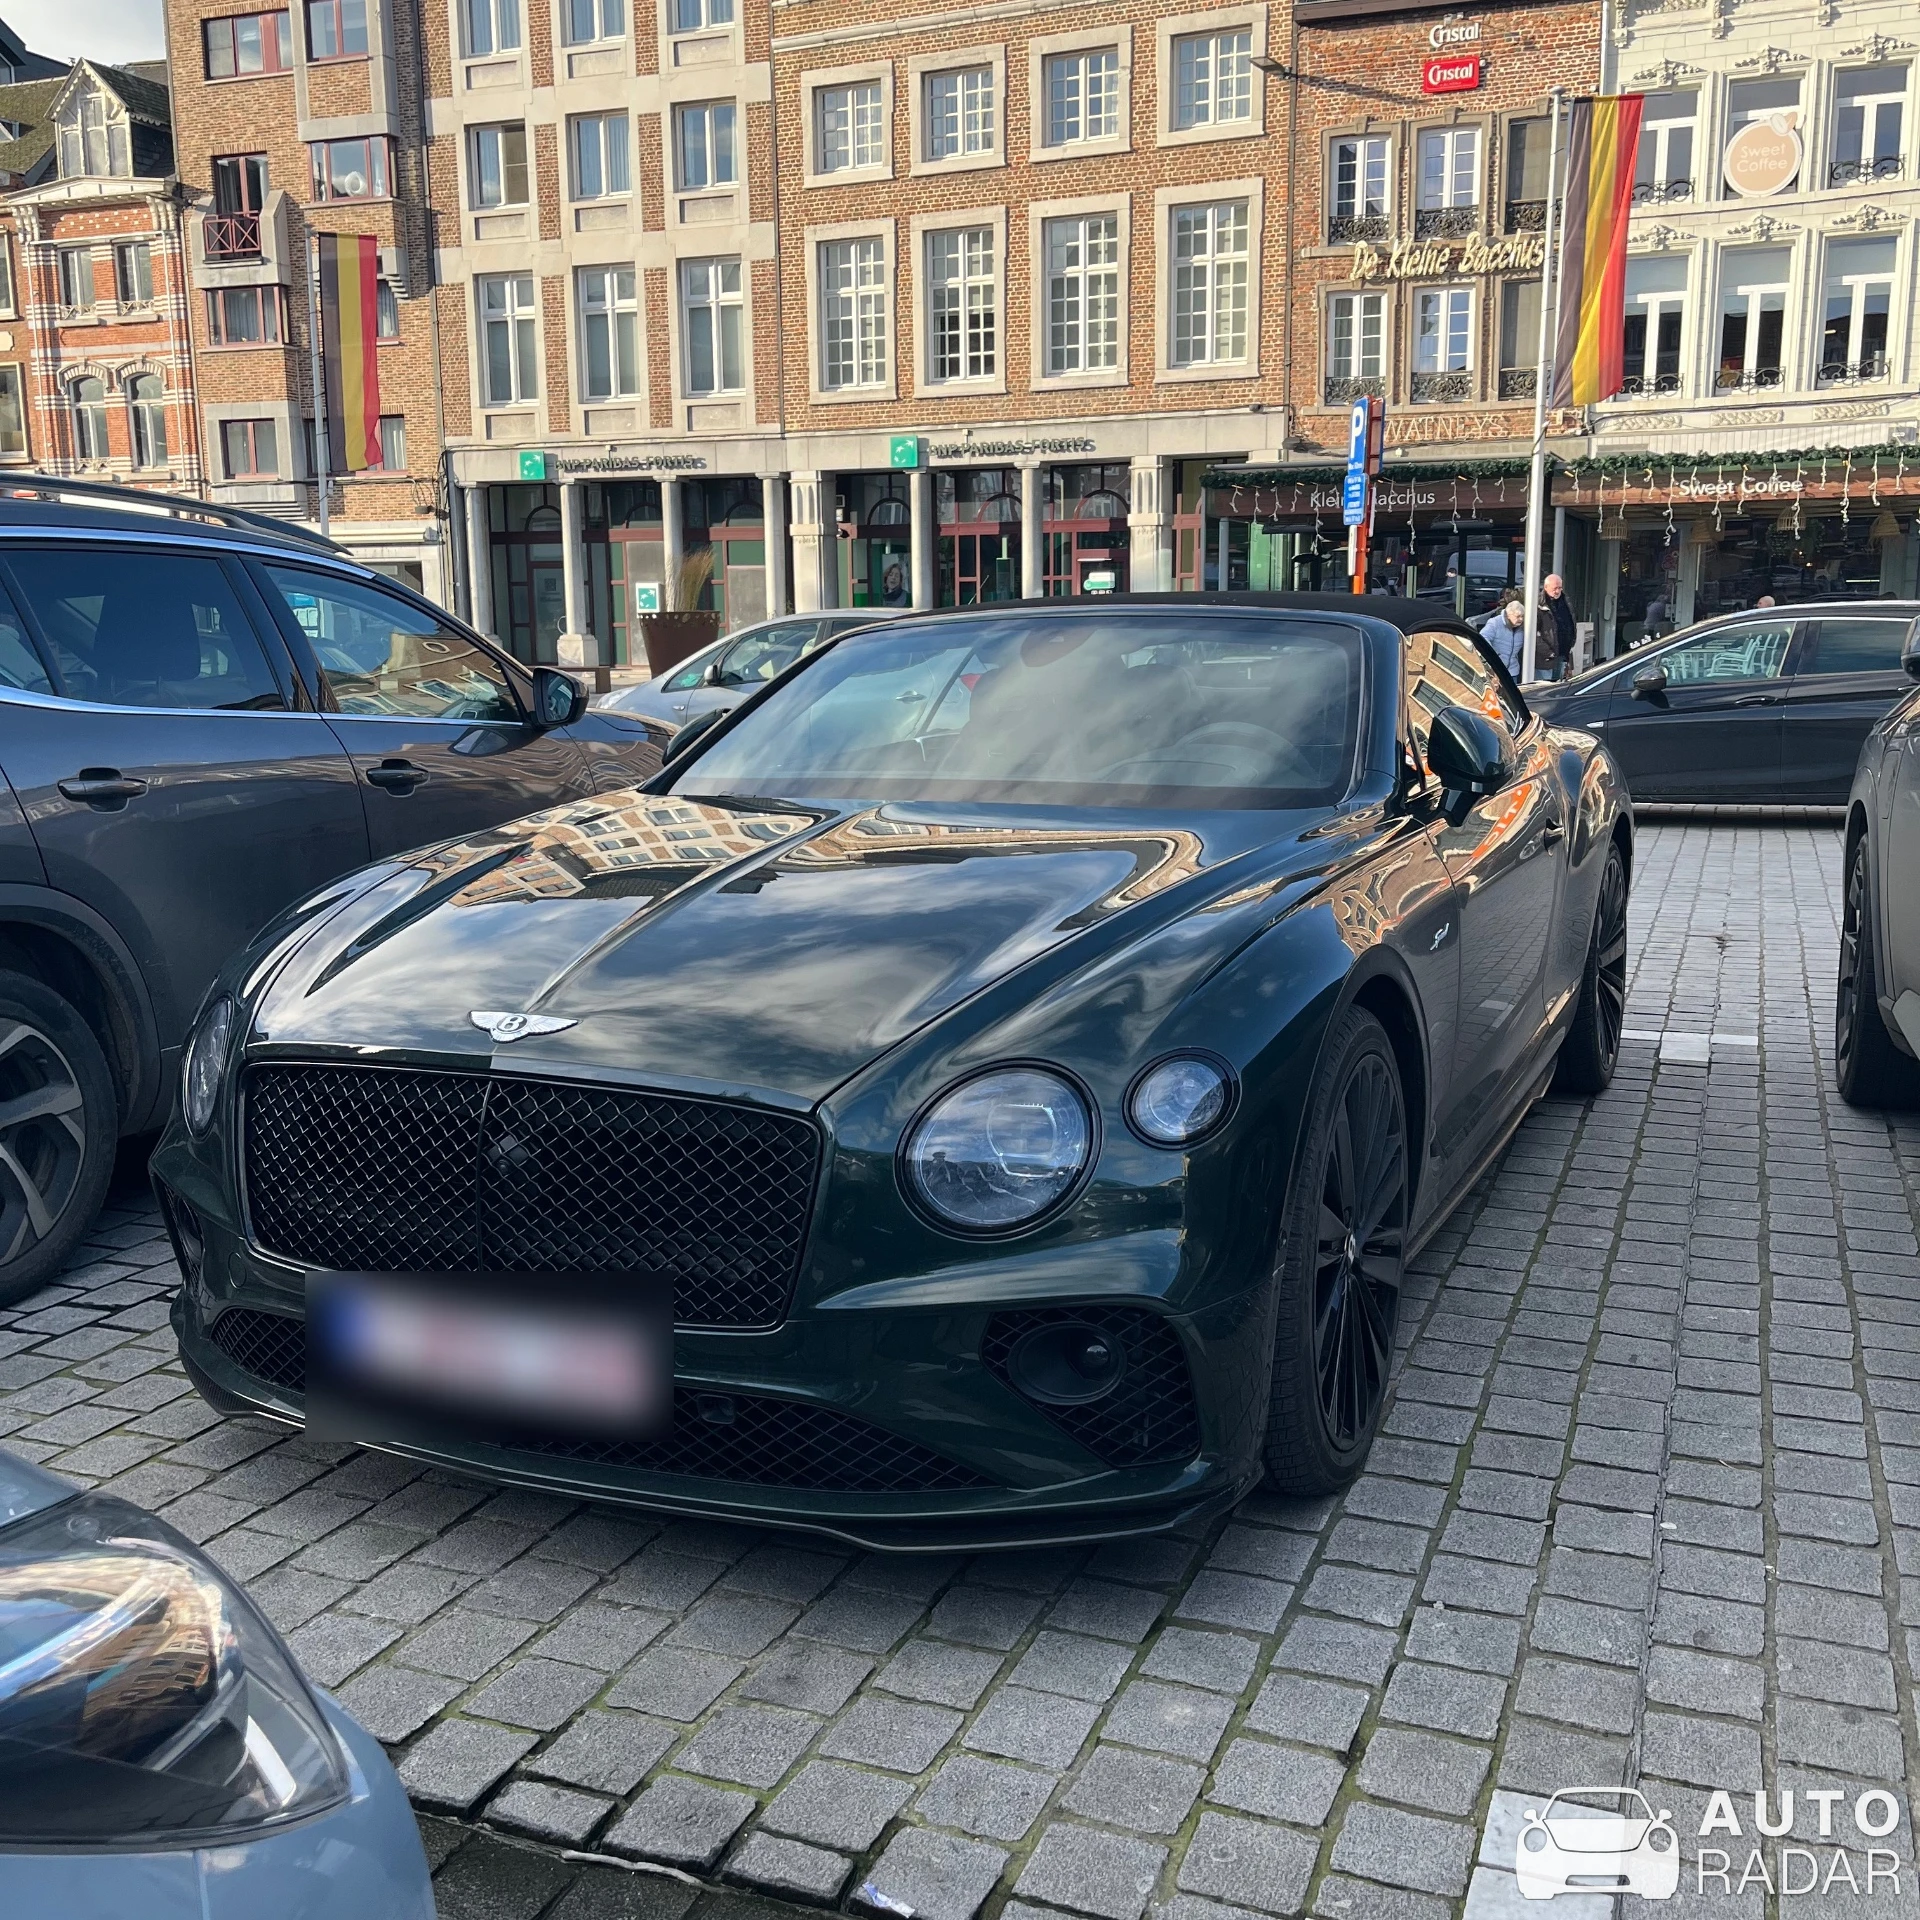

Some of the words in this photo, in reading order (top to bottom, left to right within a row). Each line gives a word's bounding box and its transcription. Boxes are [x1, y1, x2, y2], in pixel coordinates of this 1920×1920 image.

[1429, 22, 1480, 48] Cristal
[1428, 63, 1474, 86] Cristal
[1740, 143, 1786, 158] Sweet
[1736, 158, 1788, 172] Coffee
[1350, 240, 1378, 281] De
[1387, 237, 1450, 278] Kleine
[1458, 228, 1545, 273] Bacchus
[1350, 406, 1364, 459] P
[1679, 479, 1735, 496] Sweet
[1741, 476, 1804, 495] Coffee
[1375, 488, 1436, 506] acchus
